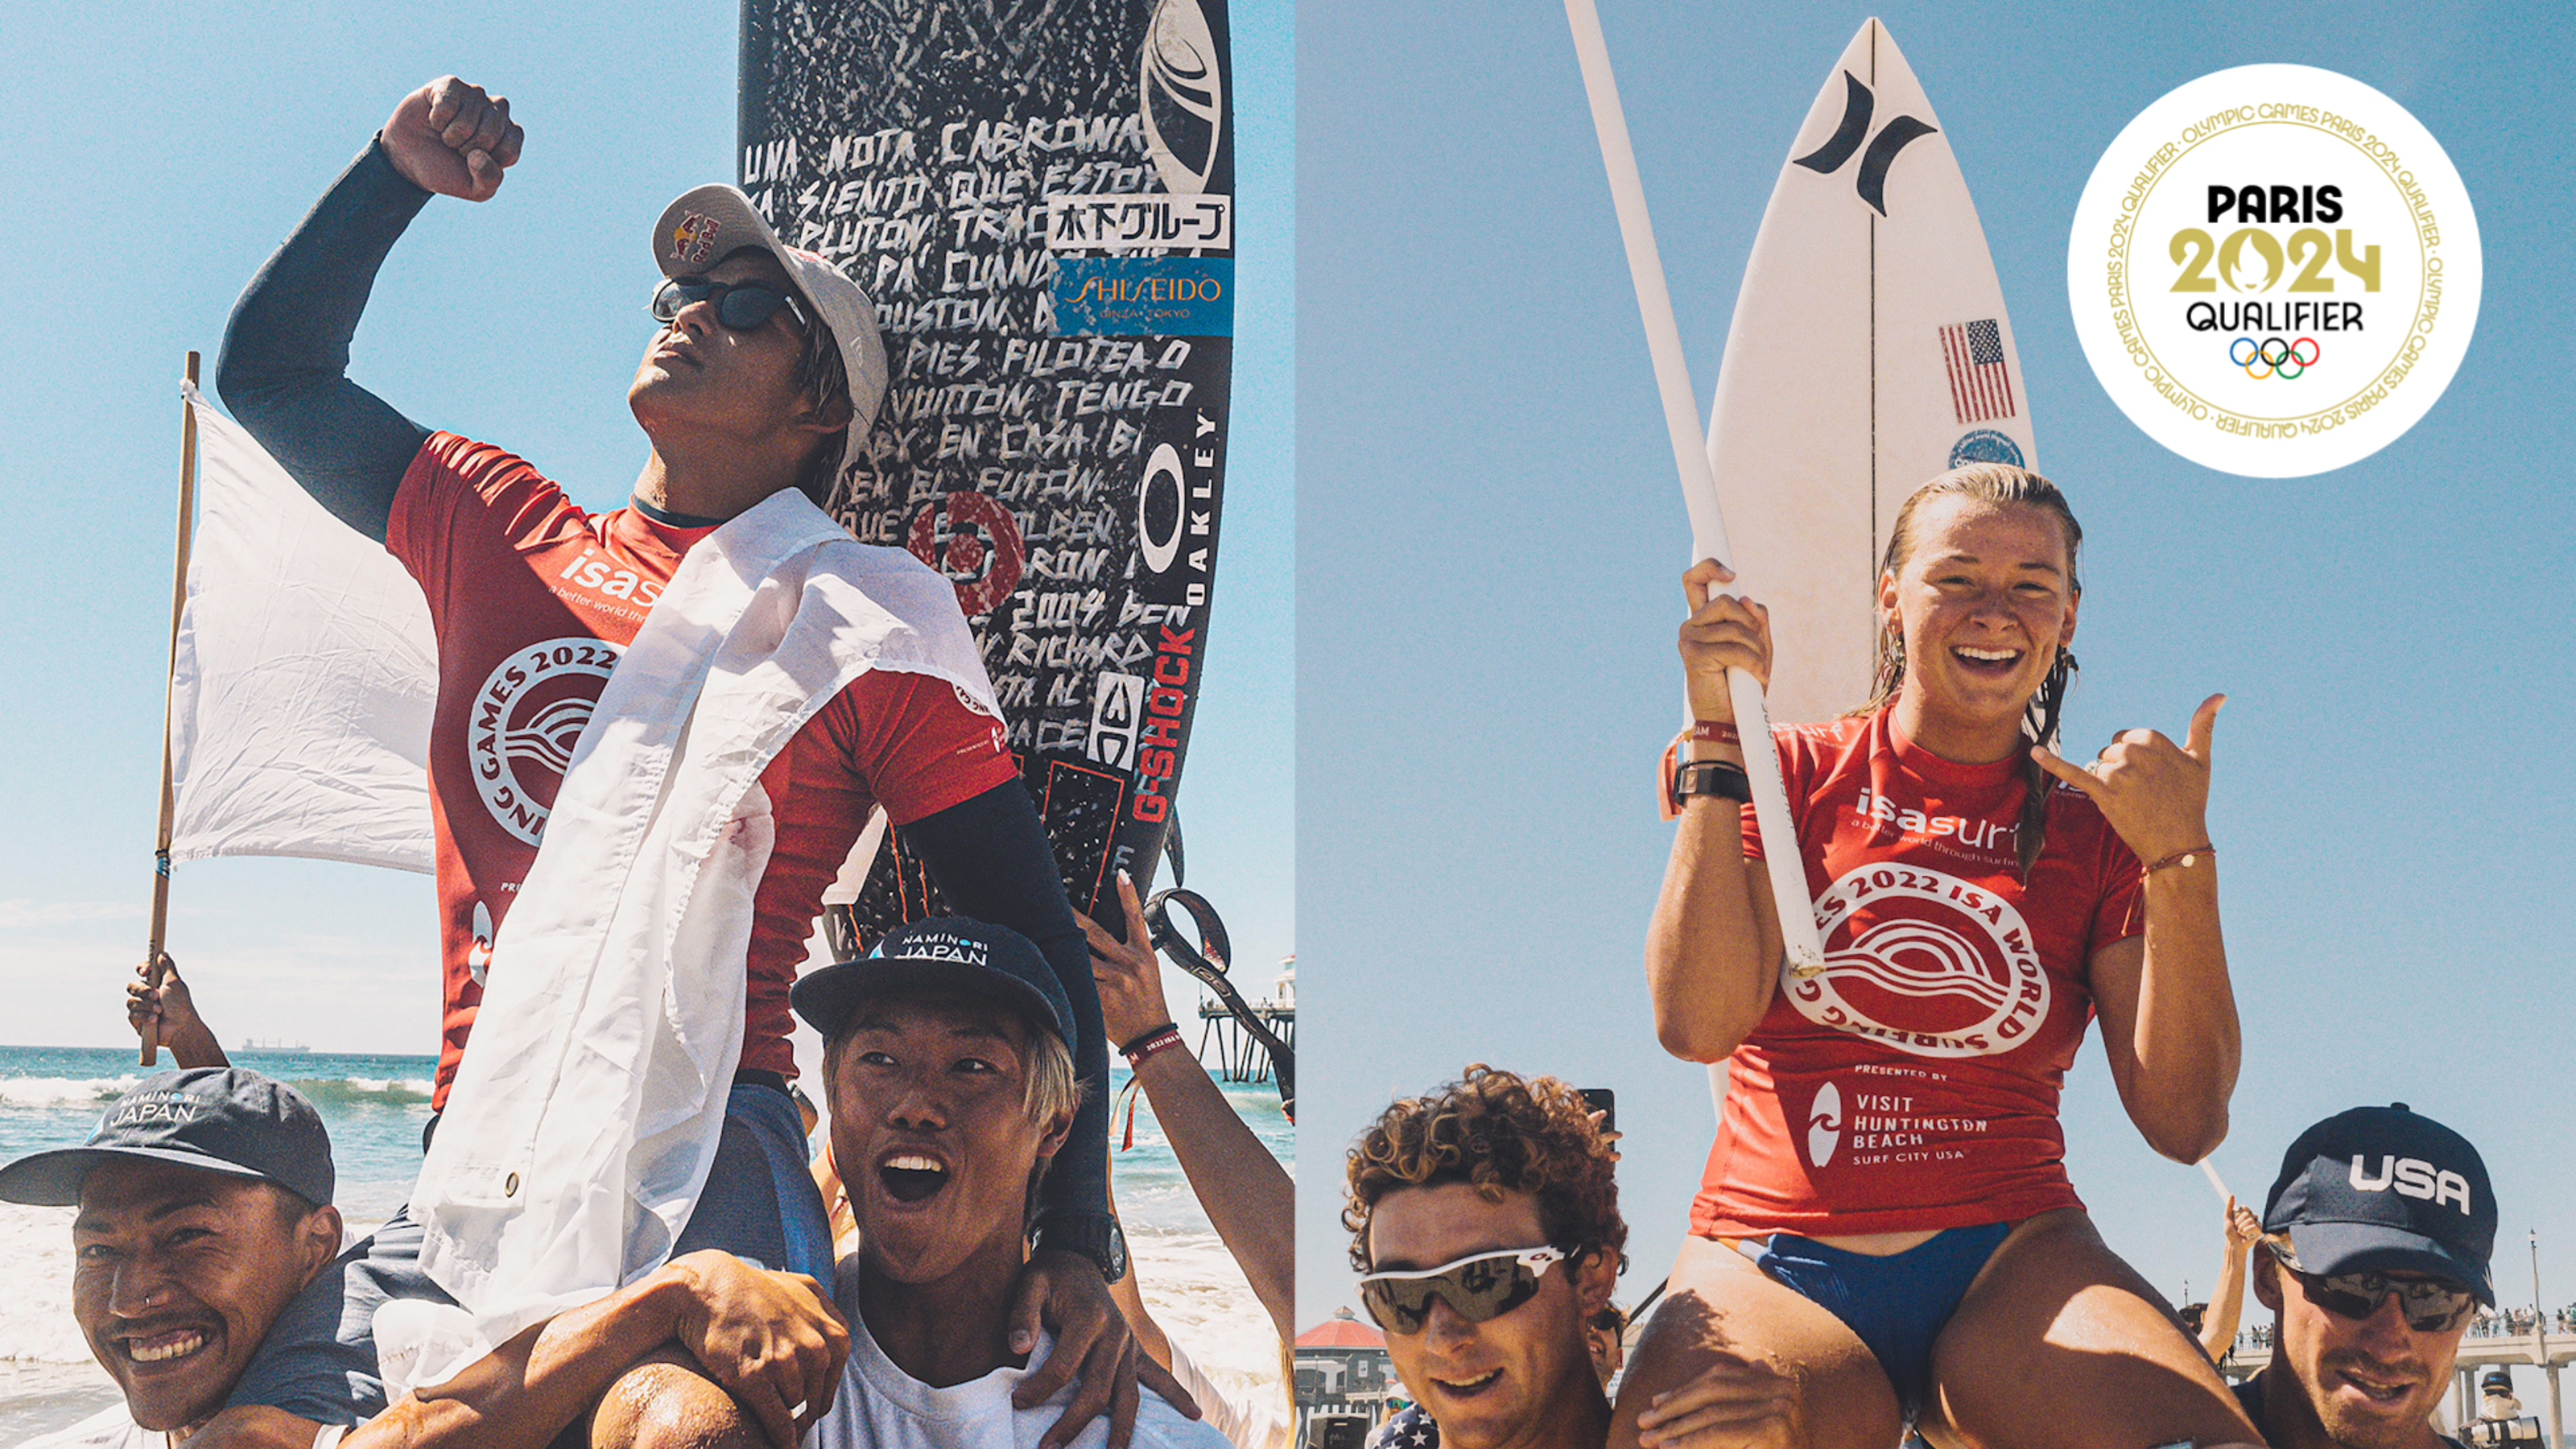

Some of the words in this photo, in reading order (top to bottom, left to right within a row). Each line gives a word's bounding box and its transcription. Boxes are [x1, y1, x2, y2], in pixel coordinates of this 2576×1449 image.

[745, 137, 801, 185] UNA
[827, 128, 916, 175] NOTA
[796, 178, 927, 225] SIENTO
[948, 169, 1024, 208] QUE
[700, 217, 721, 243] Bull
[1055, 202, 1225, 241] 木下グループ
[691, 238, 713, 262] Red
[1064, 275, 1221, 303] SHISEIDO
[1100, 308, 1138, 319] GINZA
[1147, 308, 1191, 319] TOKYO
[902, 337, 980, 378] PIES
[1054, 379, 1194, 420] TENGO
[937, 423, 984, 461] EN
[1186, 414, 1216, 605] OAKLEY
[557, 586, 592, 606] better
[594, 601, 628, 617] world
[477, 665, 527, 781] GAMES
[530, 646, 617, 673] 2022
[1132, 623, 1195, 823] G-SHOCK
[1852, 819, 1860, 828] a
[1862, 819, 1896, 838] better
[1899, 835, 1932, 848] world
[1934, 840, 1980, 862] through
[1849, 869, 1939, 899] 2022
[1948, 885, 2004, 926] ISA
[894, 945, 989, 966] JAPAN
[1996, 927, 2042, 1040] WORLD
[1821, 1005, 1989, 1050] SURFING
[1855, 1064, 1927, 1078] PRESENTED
[1932, 1073, 1947, 1081] BY
[109, 1104, 197, 1126] JAPAN
[1856, 1094, 1913, 1112] VISIT
[1853, 1133, 1923, 1149] BEACH
[1854, 1116, 1988, 1132] HUNTINGTON
[1853, 1152, 1889, 1165] SURF
[1896, 1152, 1929, 1162] CITY
[1936, 1150, 1964, 1160] USA
[2348, 1154, 2471, 1216] USA
